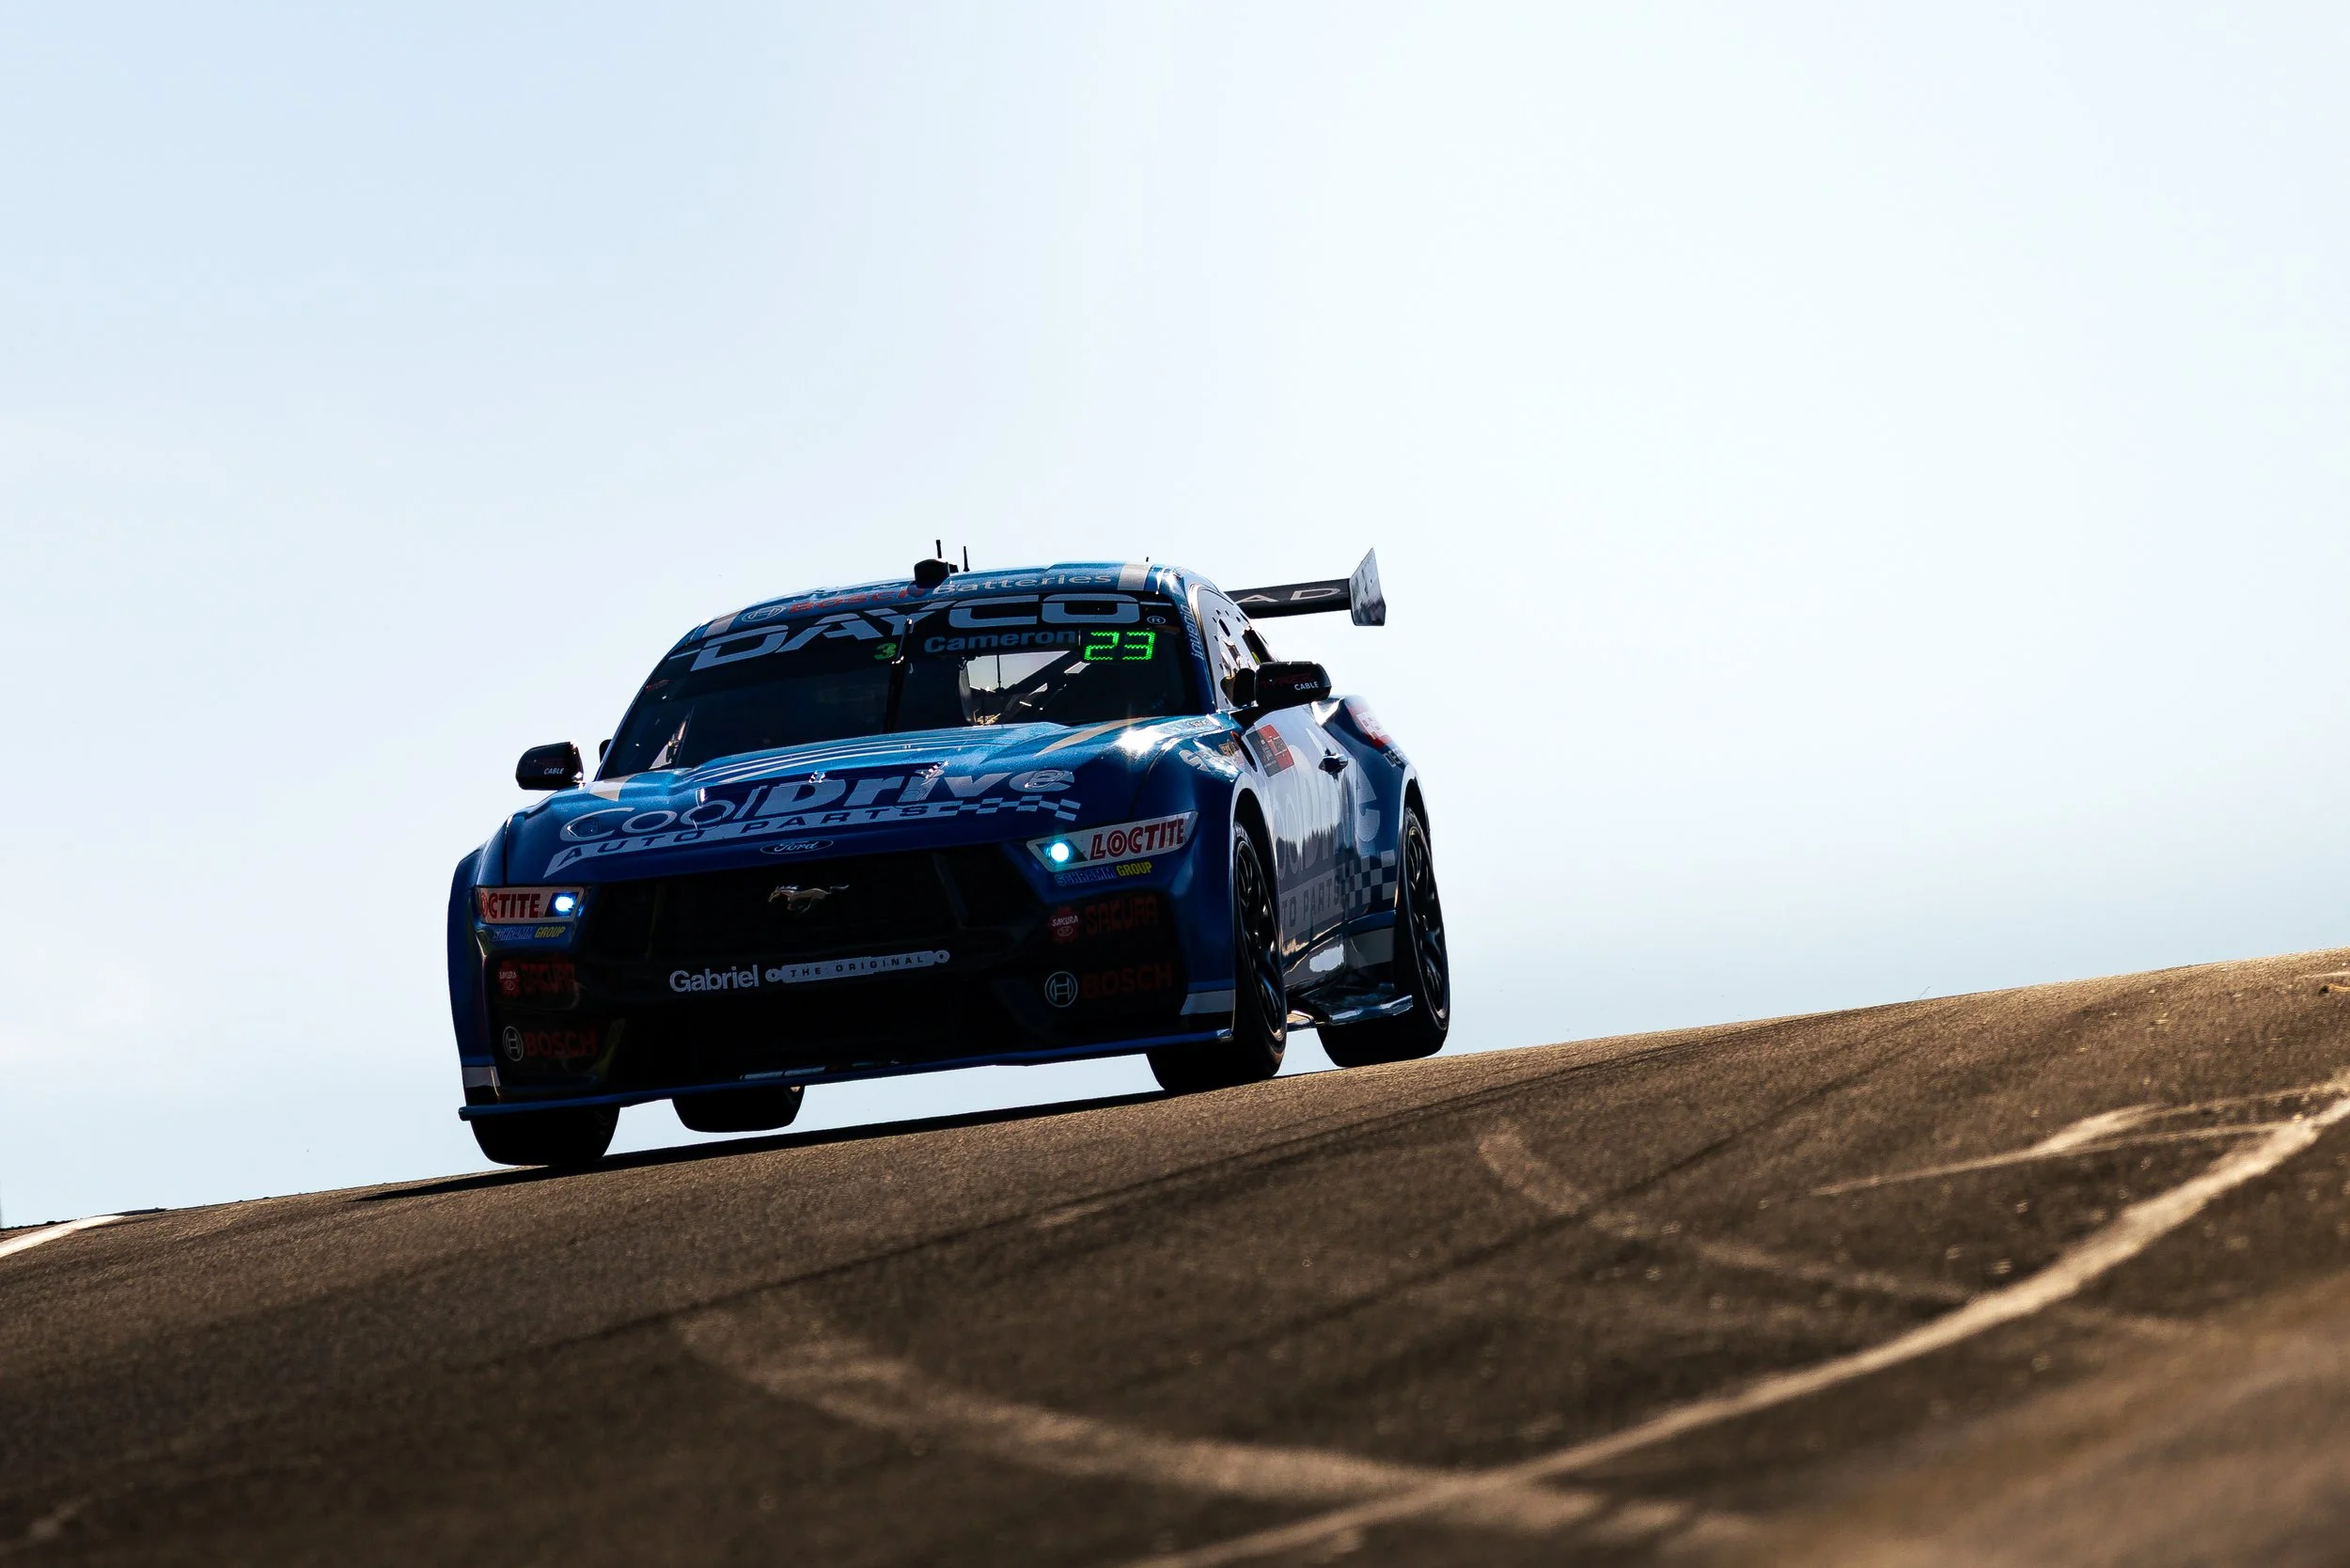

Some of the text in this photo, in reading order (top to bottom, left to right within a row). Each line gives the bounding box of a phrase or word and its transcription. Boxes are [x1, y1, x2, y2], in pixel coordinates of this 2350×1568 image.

[932, 573, 1112, 595] Batteries
[690, 593, 1140, 672] DAYCO
[924, 630, 1076, 654] Cameron
[1084, 631, 1155, 662] 23
[873, 642, 898, 661] 3
[1293, 681, 1320, 691] CABLE
[543, 767, 565, 776] CABLE
[559, 768, 1075, 841] CoolDrive
[556, 808, 930, 868] AUTO PARTS
[1089, 818, 1184, 861] LOCTITE
[1054, 861, 1153, 886] SCHRAMM GROUP
[480, 891, 540, 918] OCTITE
[1085, 893, 1159, 936] SAKURA
[534, 926, 566, 939] GROUP
[1052, 915, 1079, 927] SAKURA
[668, 955, 924, 993] Gabriel THE ORIGINAL
[1081, 960, 1173, 999] BOSCH
[524, 1029, 599, 1058] BOSCH
